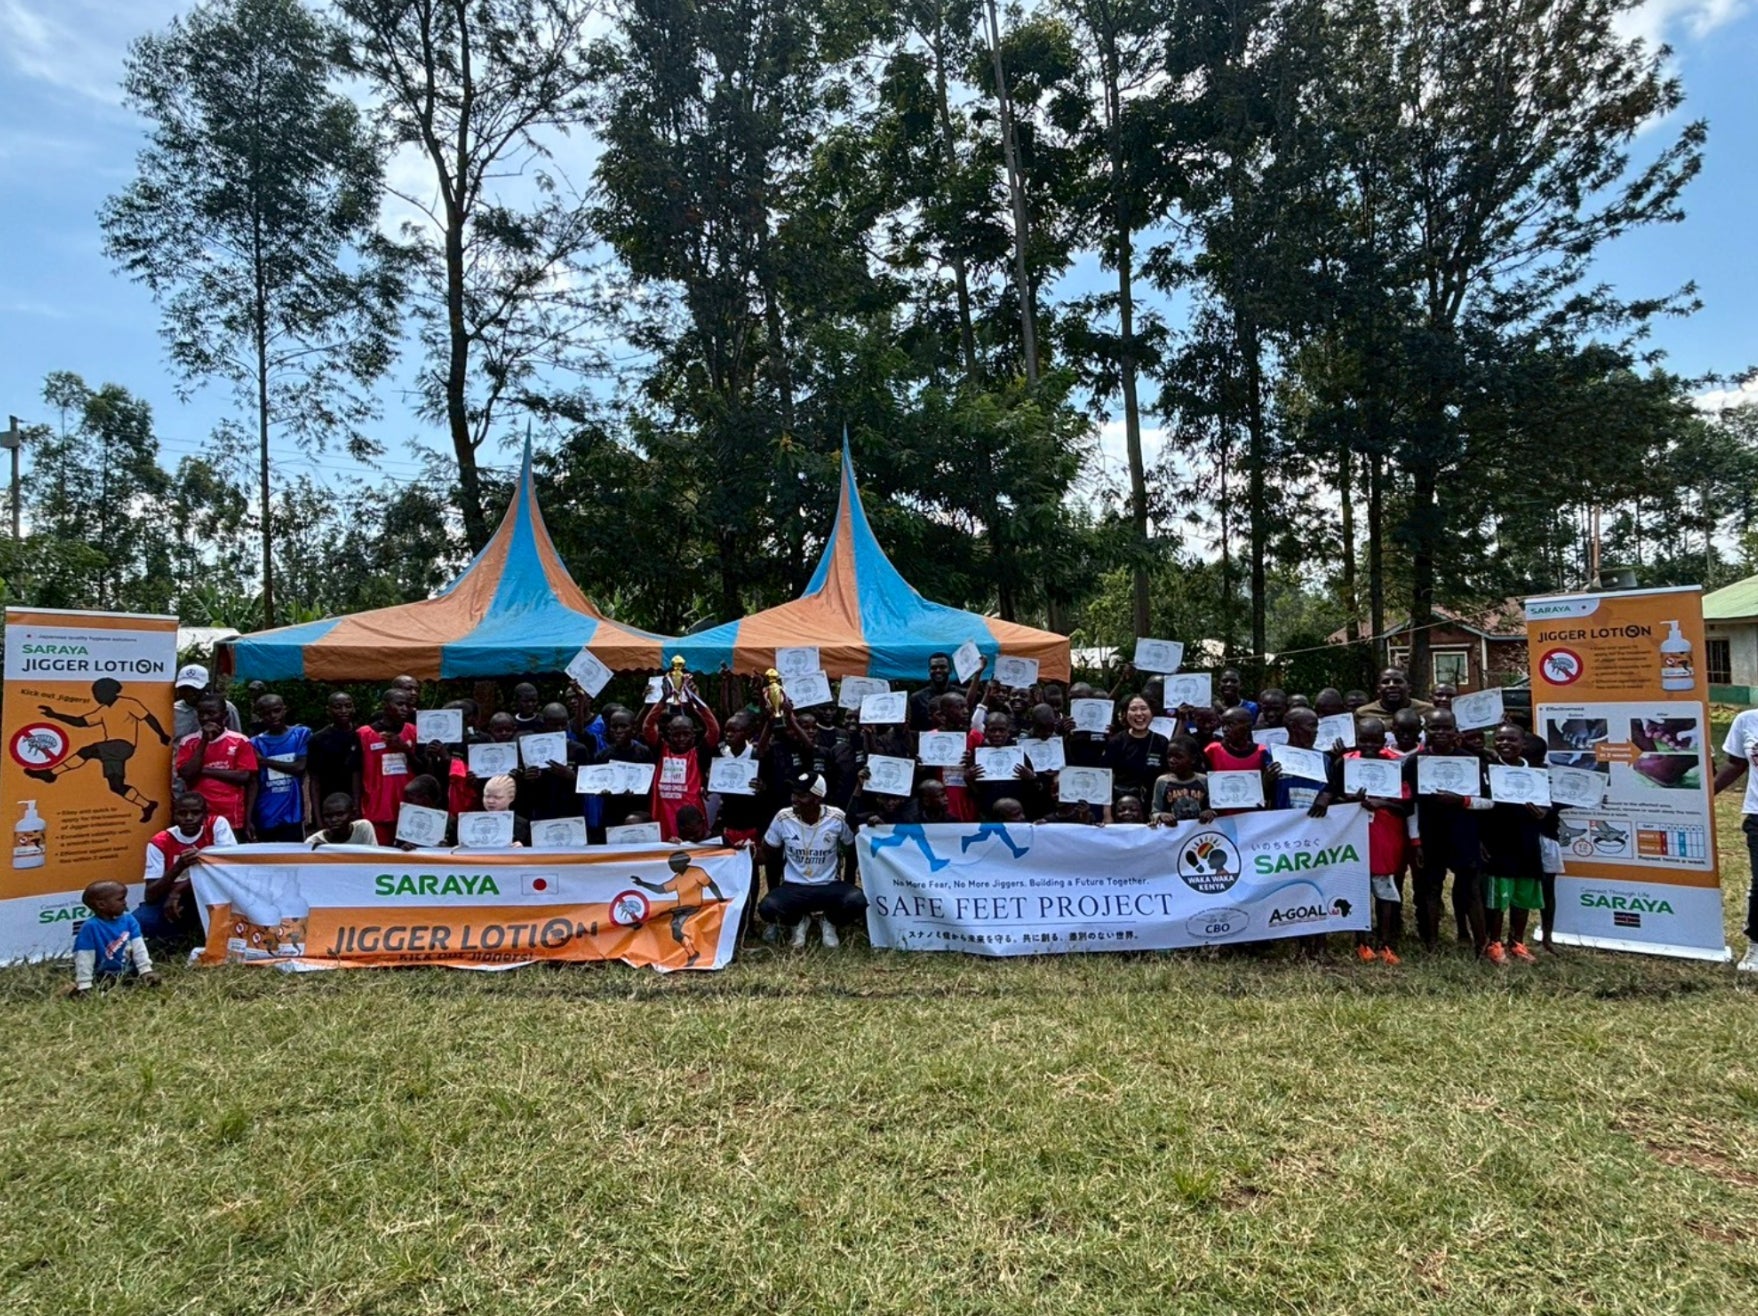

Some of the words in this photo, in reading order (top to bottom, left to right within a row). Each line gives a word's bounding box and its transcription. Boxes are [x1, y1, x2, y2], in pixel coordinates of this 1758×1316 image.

[1531, 605, 1571, 615] SARAYA
[1537, 629, 1587, 643] JIGGER
[1590, 625, 1652, 639] LOTION
[22, 644, 89, 656] SARAYA
[22, 658, 89, 673] JIGGER
[94, 659, 164, 674] LOTION
[1251, 838, 1320, 851] いのちをつなぐ
[1254, 844, 1360, 875] SARAYA
[375, 874, 500, 896] SARAYA
[892, 879, 905, 887] No
[906, 880, 926, 889] More
[928, 880, 952, 890] Fear,
[954, 880, 966, 889] No
[968, 880, 990, 888] More
[992, 880, 1026, 889] Jiggers.
[1029, 878, 1065, 888] Building
[1075, 877, 1104, 887] Future
[1106, 876, 1150, 888] Together.
[1187, 876, 1211, 884] WAKA
[1211, 874, 1235, 883] WAKA
[1198, 882, 1226, 891] KENYA
[876, 895, 945, 919] SAFE
[956, 896, 1027, 920] FEET
[1038, 893, 1173, 918] PROJECT
[1579, 893, 1675, 915] SARAYA
[1269, 904, 1327, 923] A-GOAL
[333, 925, 450, 955] JIGGER
[461, 918, 598, 950] LOTION
[1205, 923, 1231, 934] CBO
